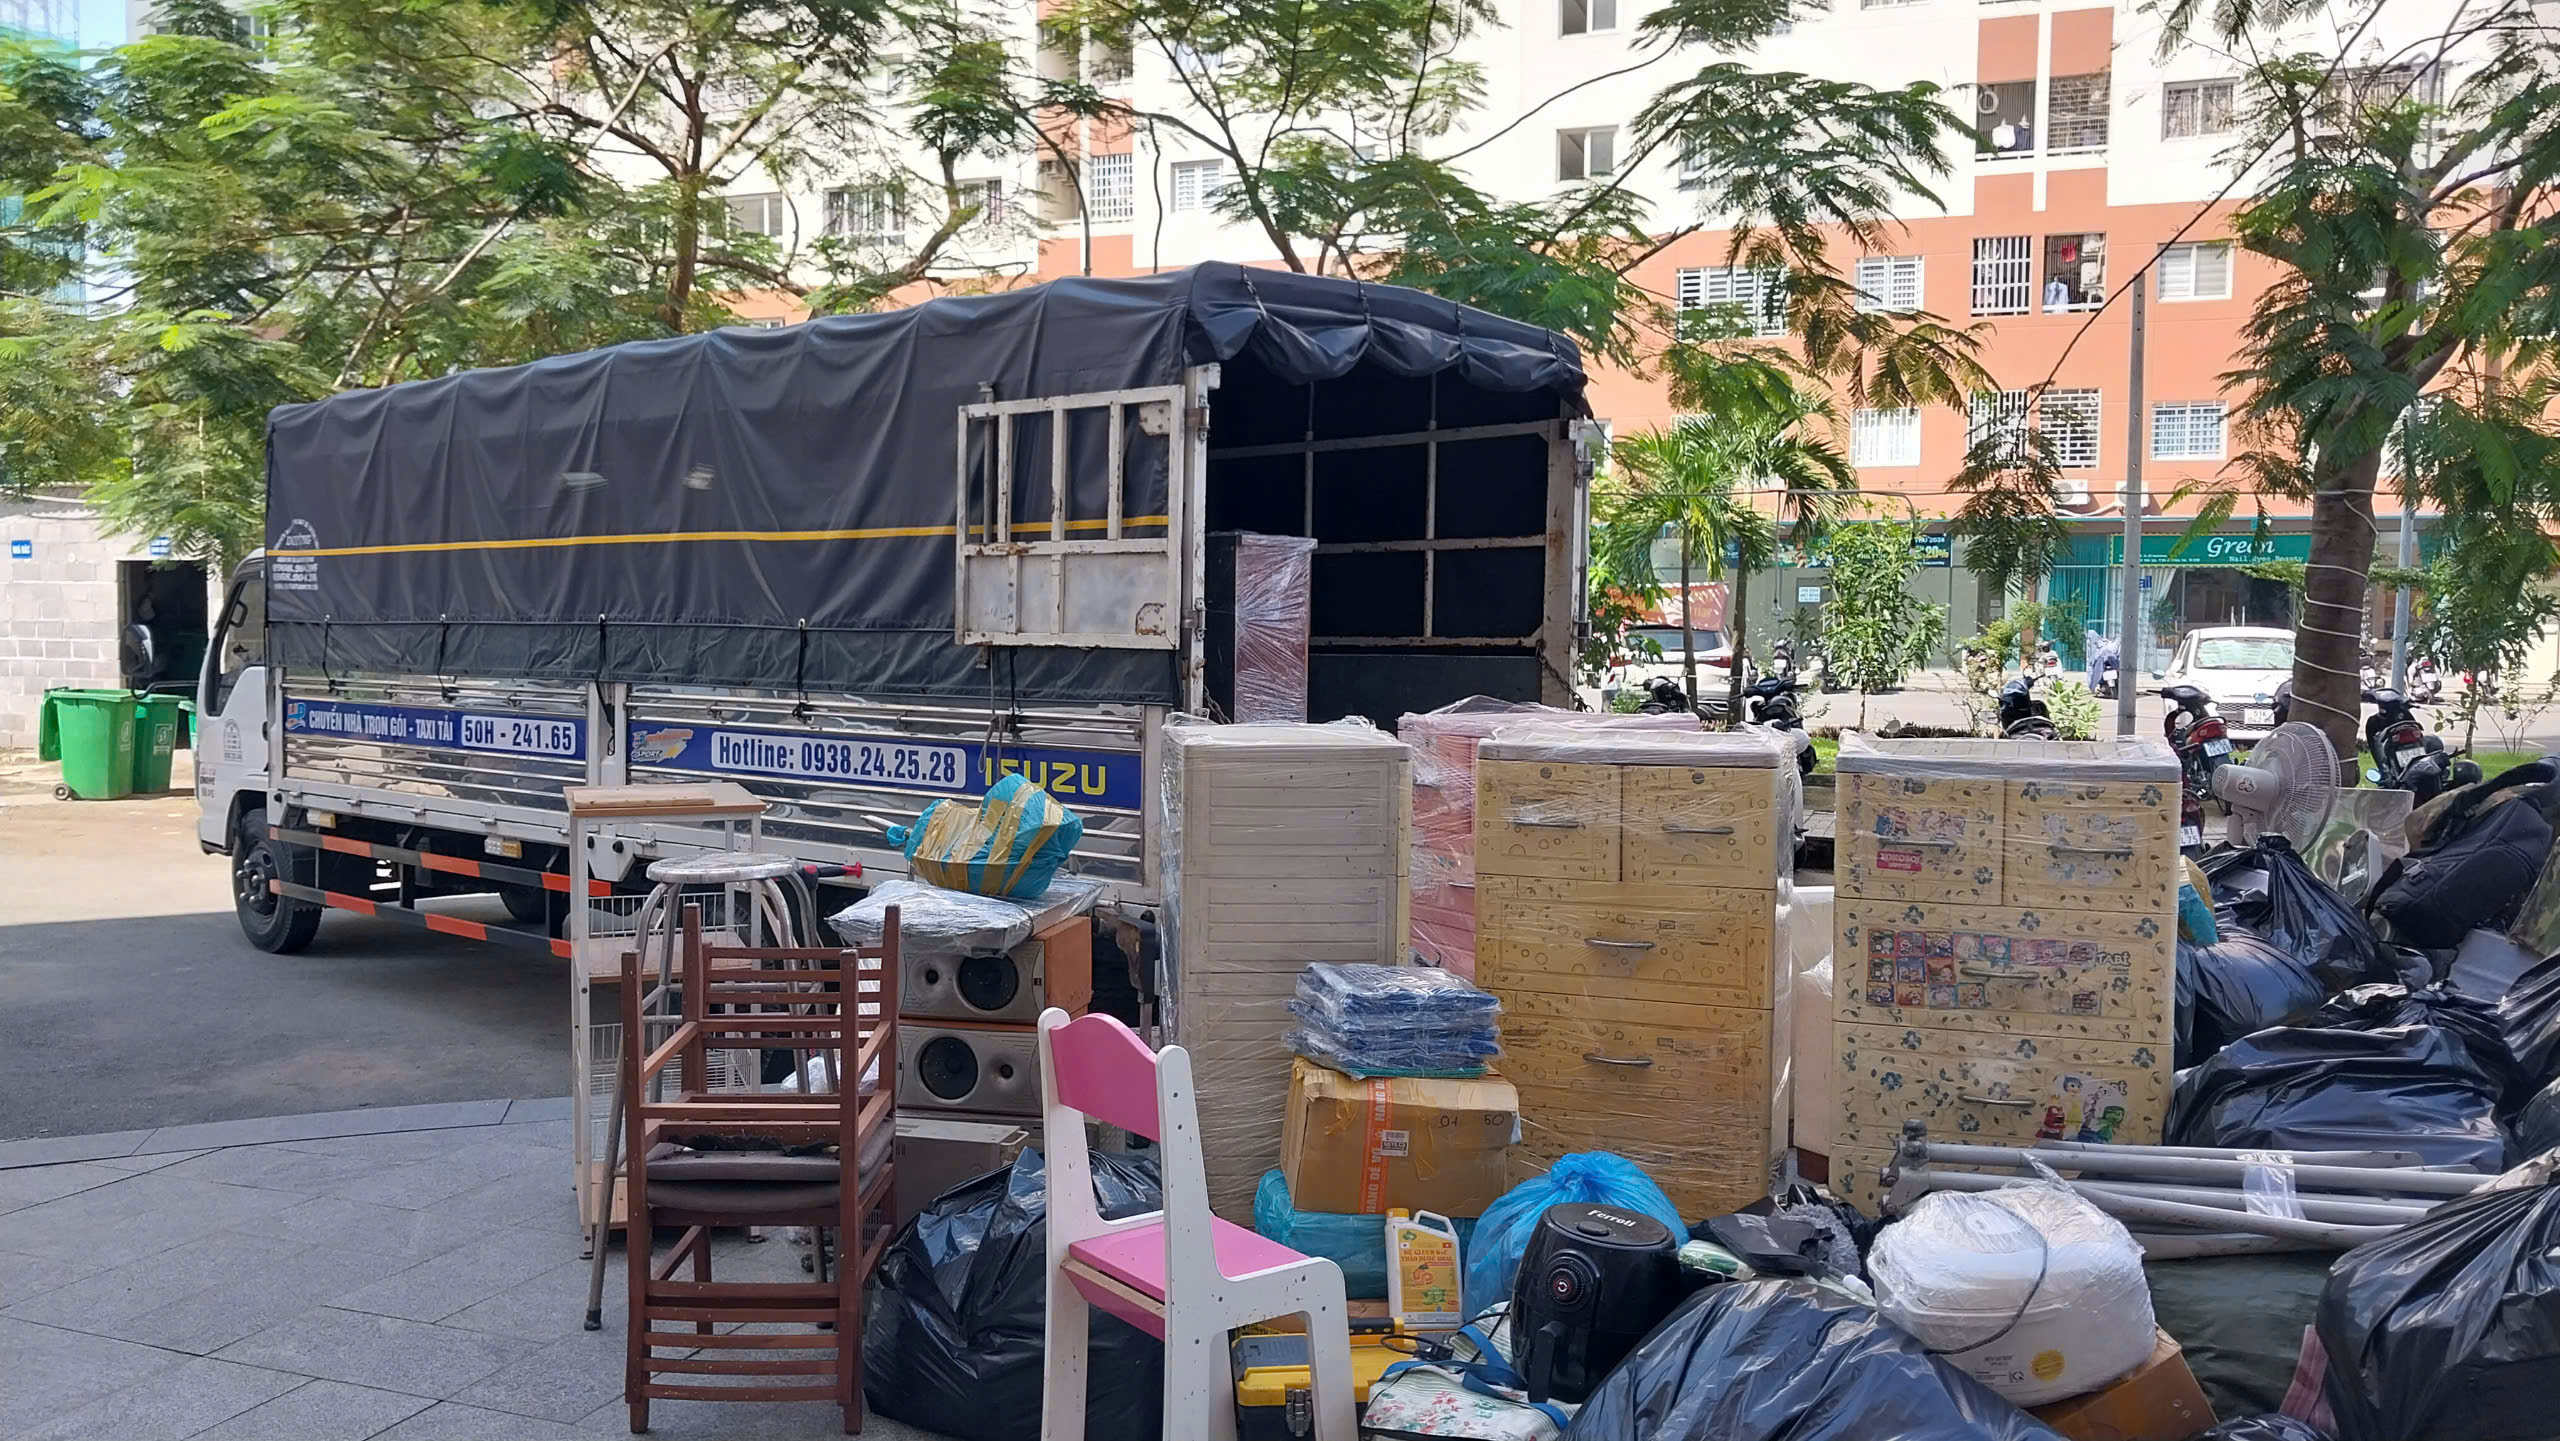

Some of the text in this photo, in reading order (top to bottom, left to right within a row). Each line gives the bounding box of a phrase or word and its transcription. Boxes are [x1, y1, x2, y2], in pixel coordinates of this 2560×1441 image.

[309, 705, 342, 731] CHUYỂN
[344, 710, 362, 733] NHÀ
[364, 715, 388, 739] TRỌN
[390, 713, 407, 737] GÓI
[415, 719, 436, 740] TAXI
[437, 714, 453, 741] TẢI
[464, 720, 494, 744] 50H
[512, 723, 571, 750] 241.65
[719, 736, 956, 783] Hotline: 0938.24.25.28
[985, 758, 1105, 795] ISUZU
